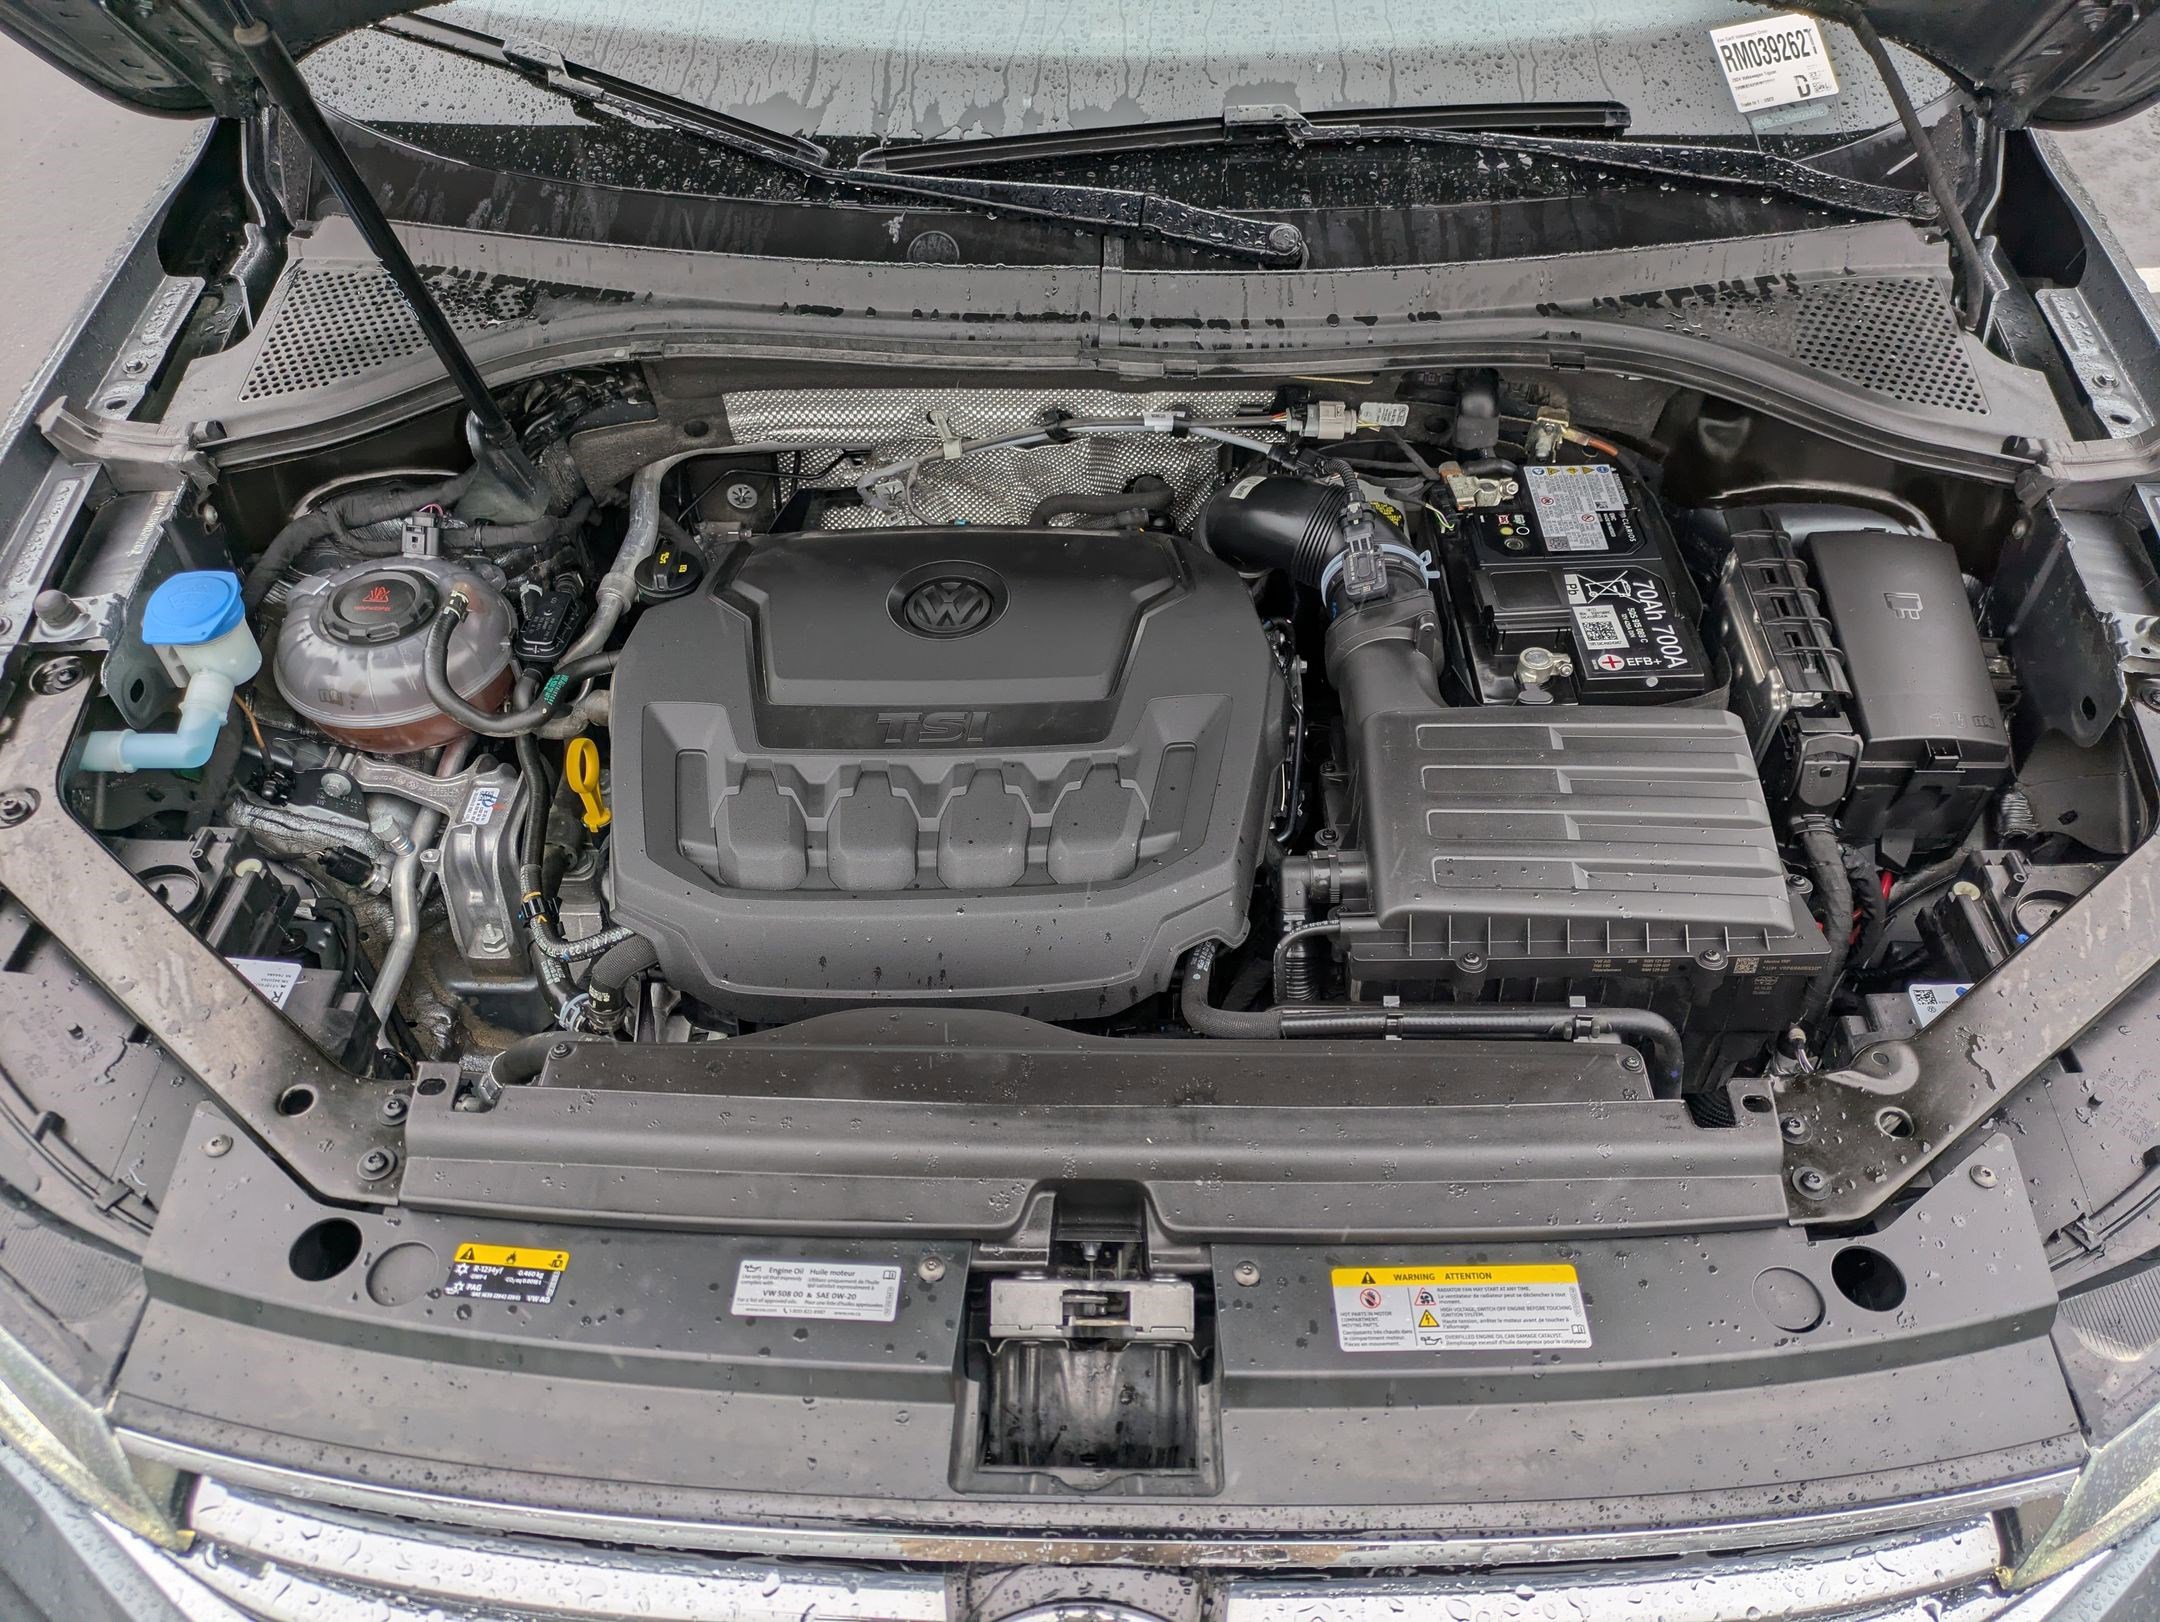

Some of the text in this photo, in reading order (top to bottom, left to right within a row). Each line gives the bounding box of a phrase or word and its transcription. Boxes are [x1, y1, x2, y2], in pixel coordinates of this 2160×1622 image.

[1567, 583, 1577, 597] Pb
[1632, 580, 1688, 669] 70Ah 700A
[1626, 656, 1662, 667] EFB+
[875, 711, 991, 743] TSI
[270, 990, 283, 1002] R
[769, 1267, 793, 1275] Engine
[1393, 1271, 1493, 1282] WARNING ATTENTION
[465, 1283, 482, 1291] PAG
[777, 1290, 792, 1298] 508
